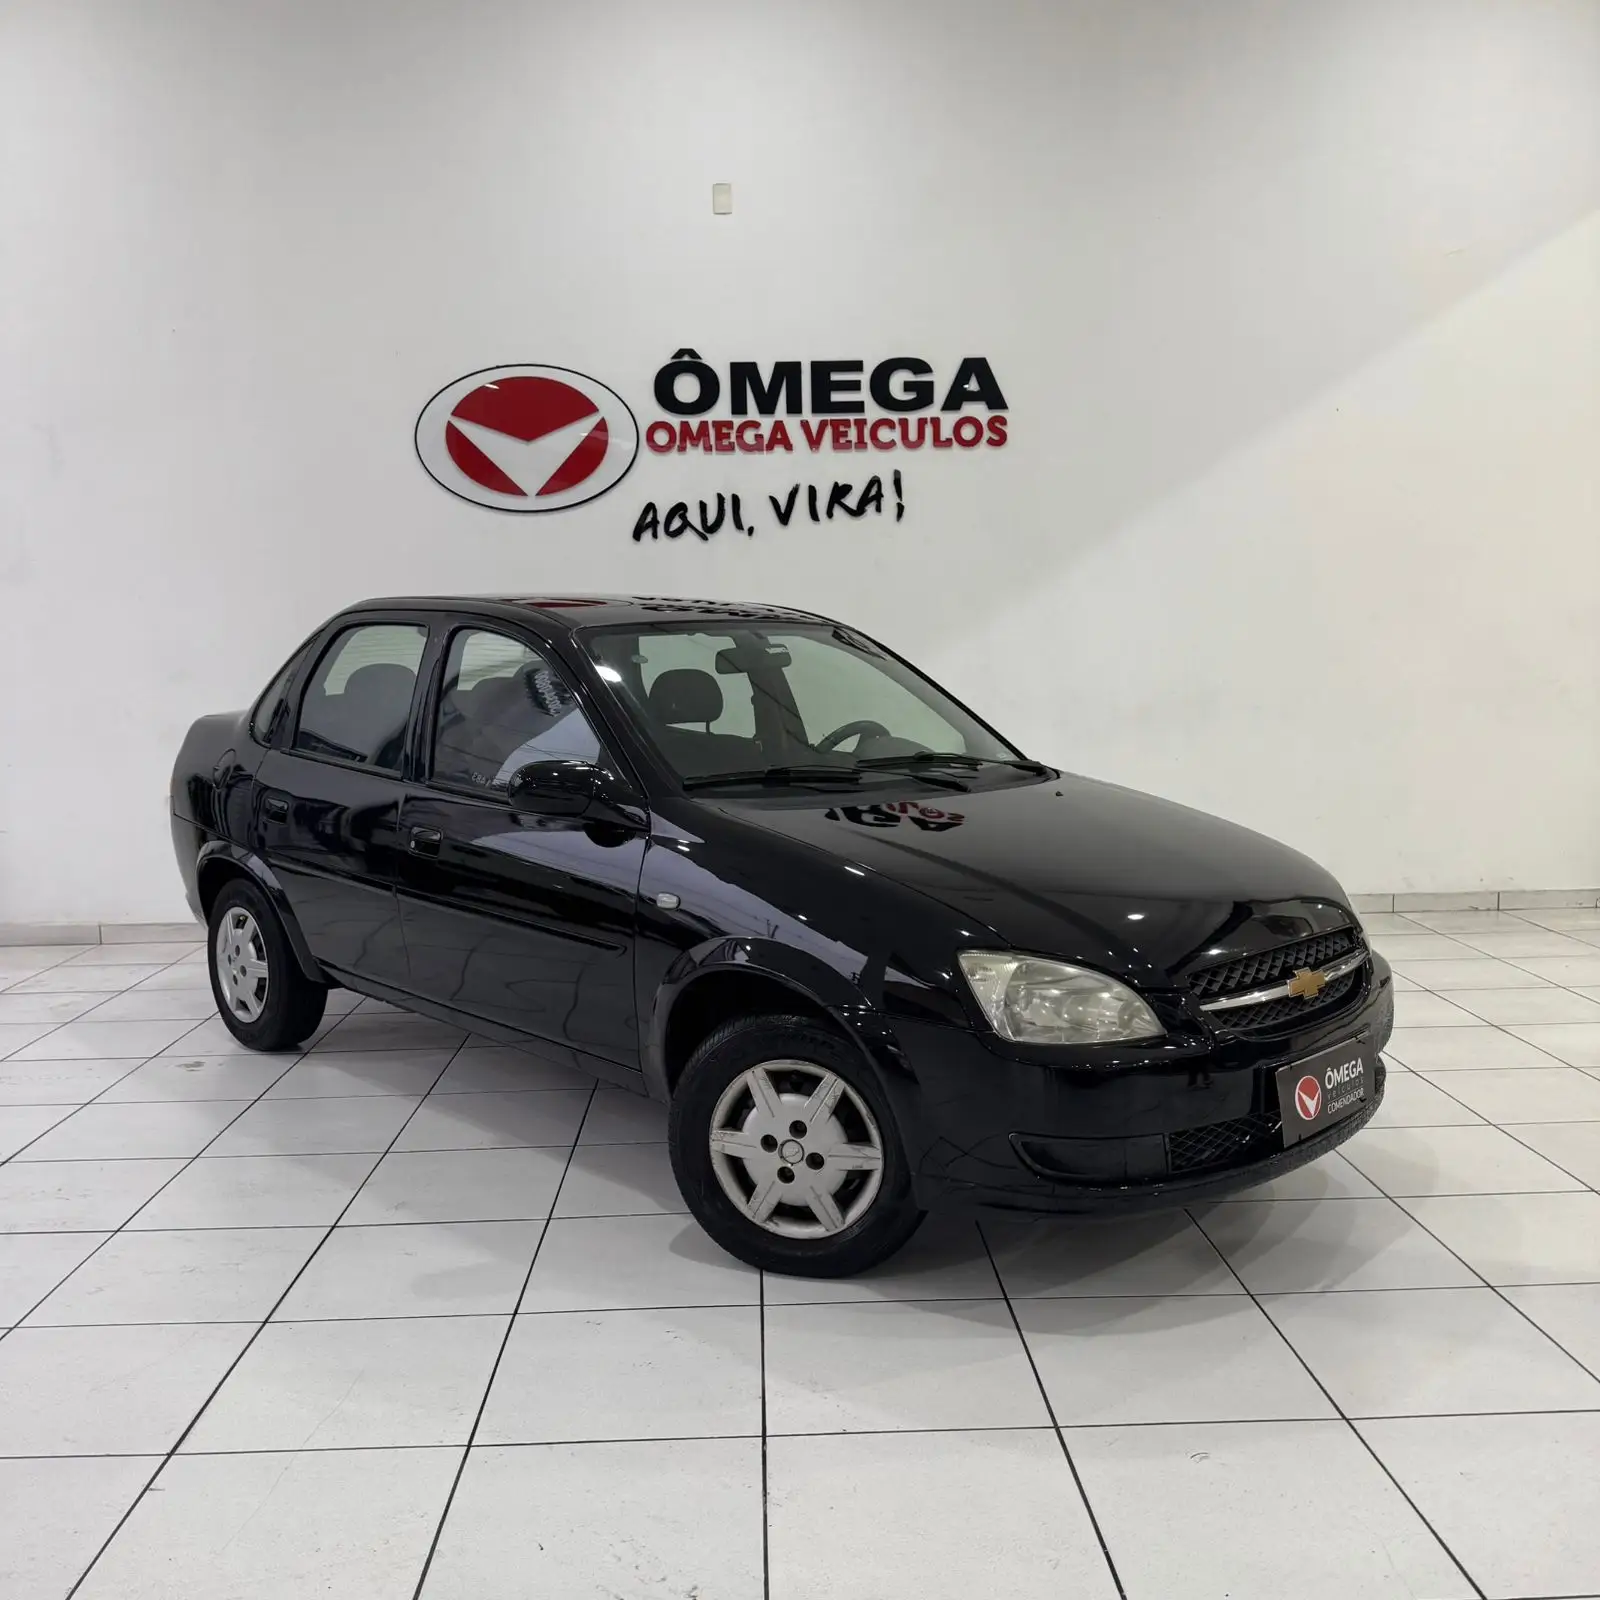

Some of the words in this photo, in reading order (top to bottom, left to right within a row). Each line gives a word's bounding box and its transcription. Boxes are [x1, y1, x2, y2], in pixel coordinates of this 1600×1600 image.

[653, 348, 1009, 416] ÔMEGA
[645, 420, 793, 453] OMEGA
[801, 415, 1009, 451] VEICULOS
[632, 492, 754, 542] AQUI,
[769, 469, 905, 526] VIRA!
[1324, 1057, 1364, 1089] ÔMEGA
[1327, 1088, 1365, 1114] COMENDADOR
